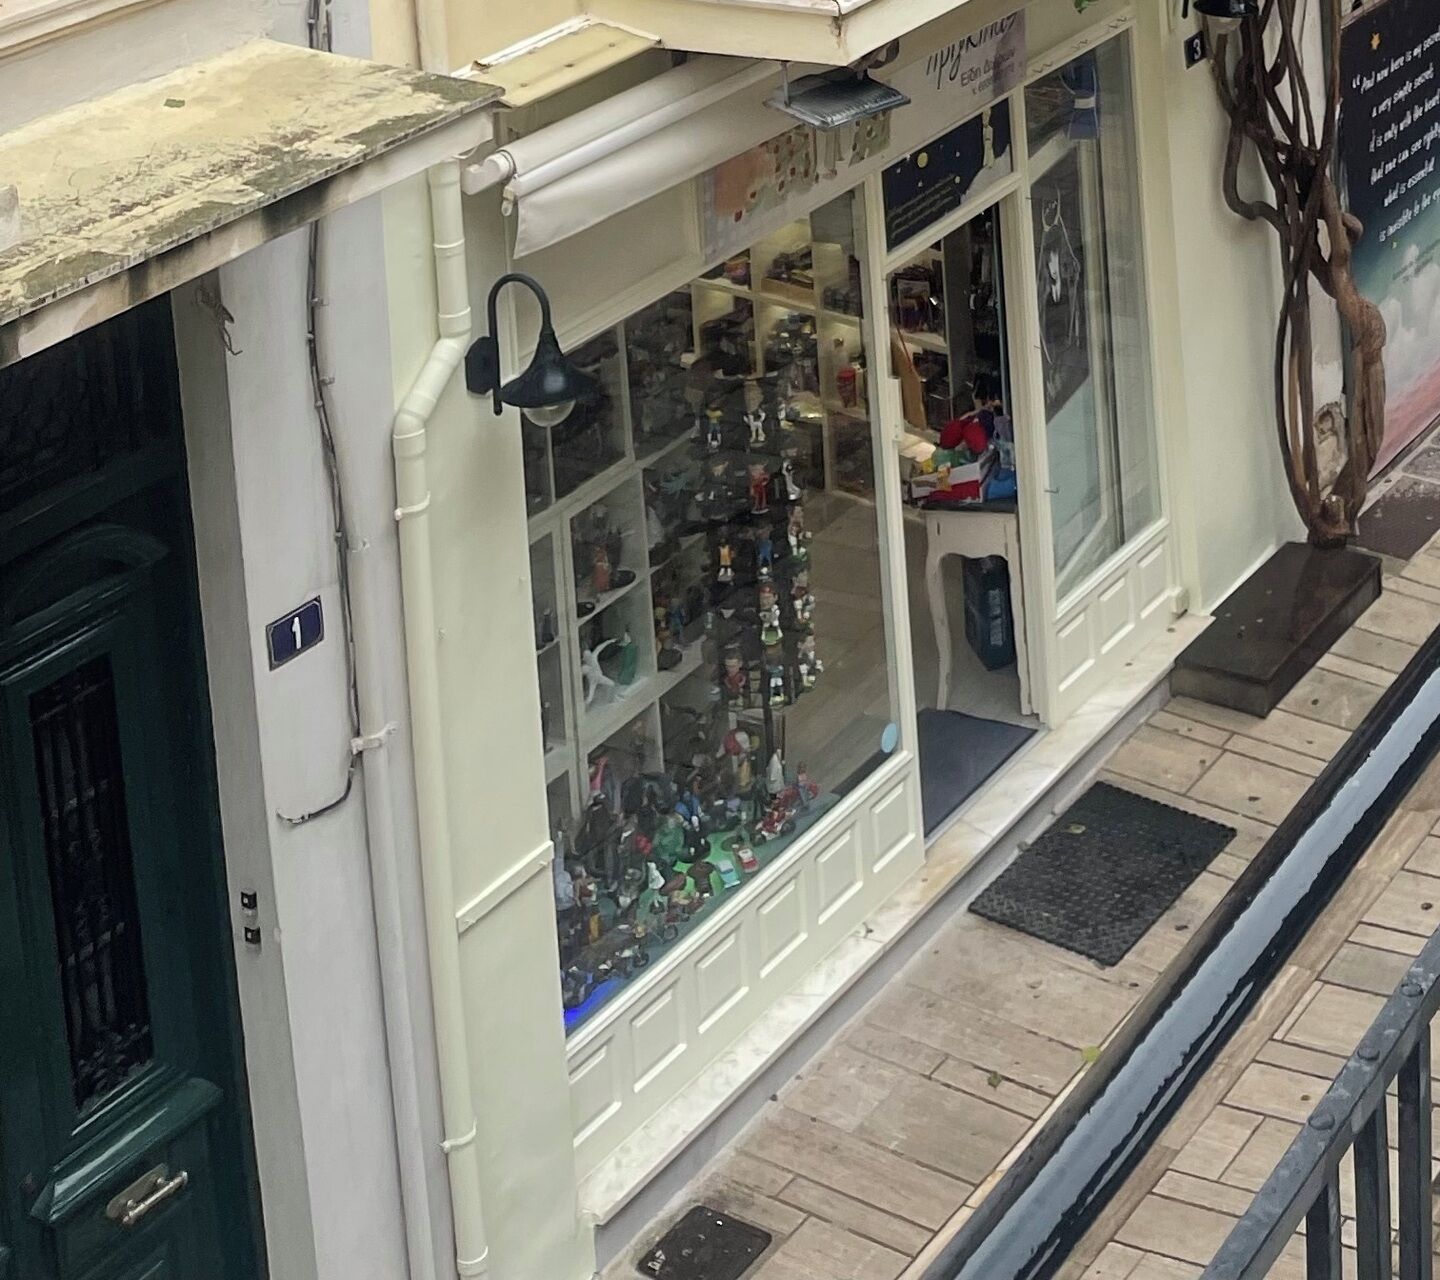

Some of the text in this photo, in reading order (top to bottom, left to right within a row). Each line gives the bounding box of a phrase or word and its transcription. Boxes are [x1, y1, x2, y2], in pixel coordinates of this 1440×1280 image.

[1193, 38, 1202, 60] 3
[1390, 57, 1404, 73] here
[1405, 50, 1412, 62] is
[1376, 135, 1383, 147] is
[1413, 104, 1423, 122] the
[1397, 149, 1409, 164] can
[1410, 138, 1422, 155] see
[1399, 182, 1407, 194] is
[1407, 156, 1435, 189] essential
[291, 617, 302, 649] 1
